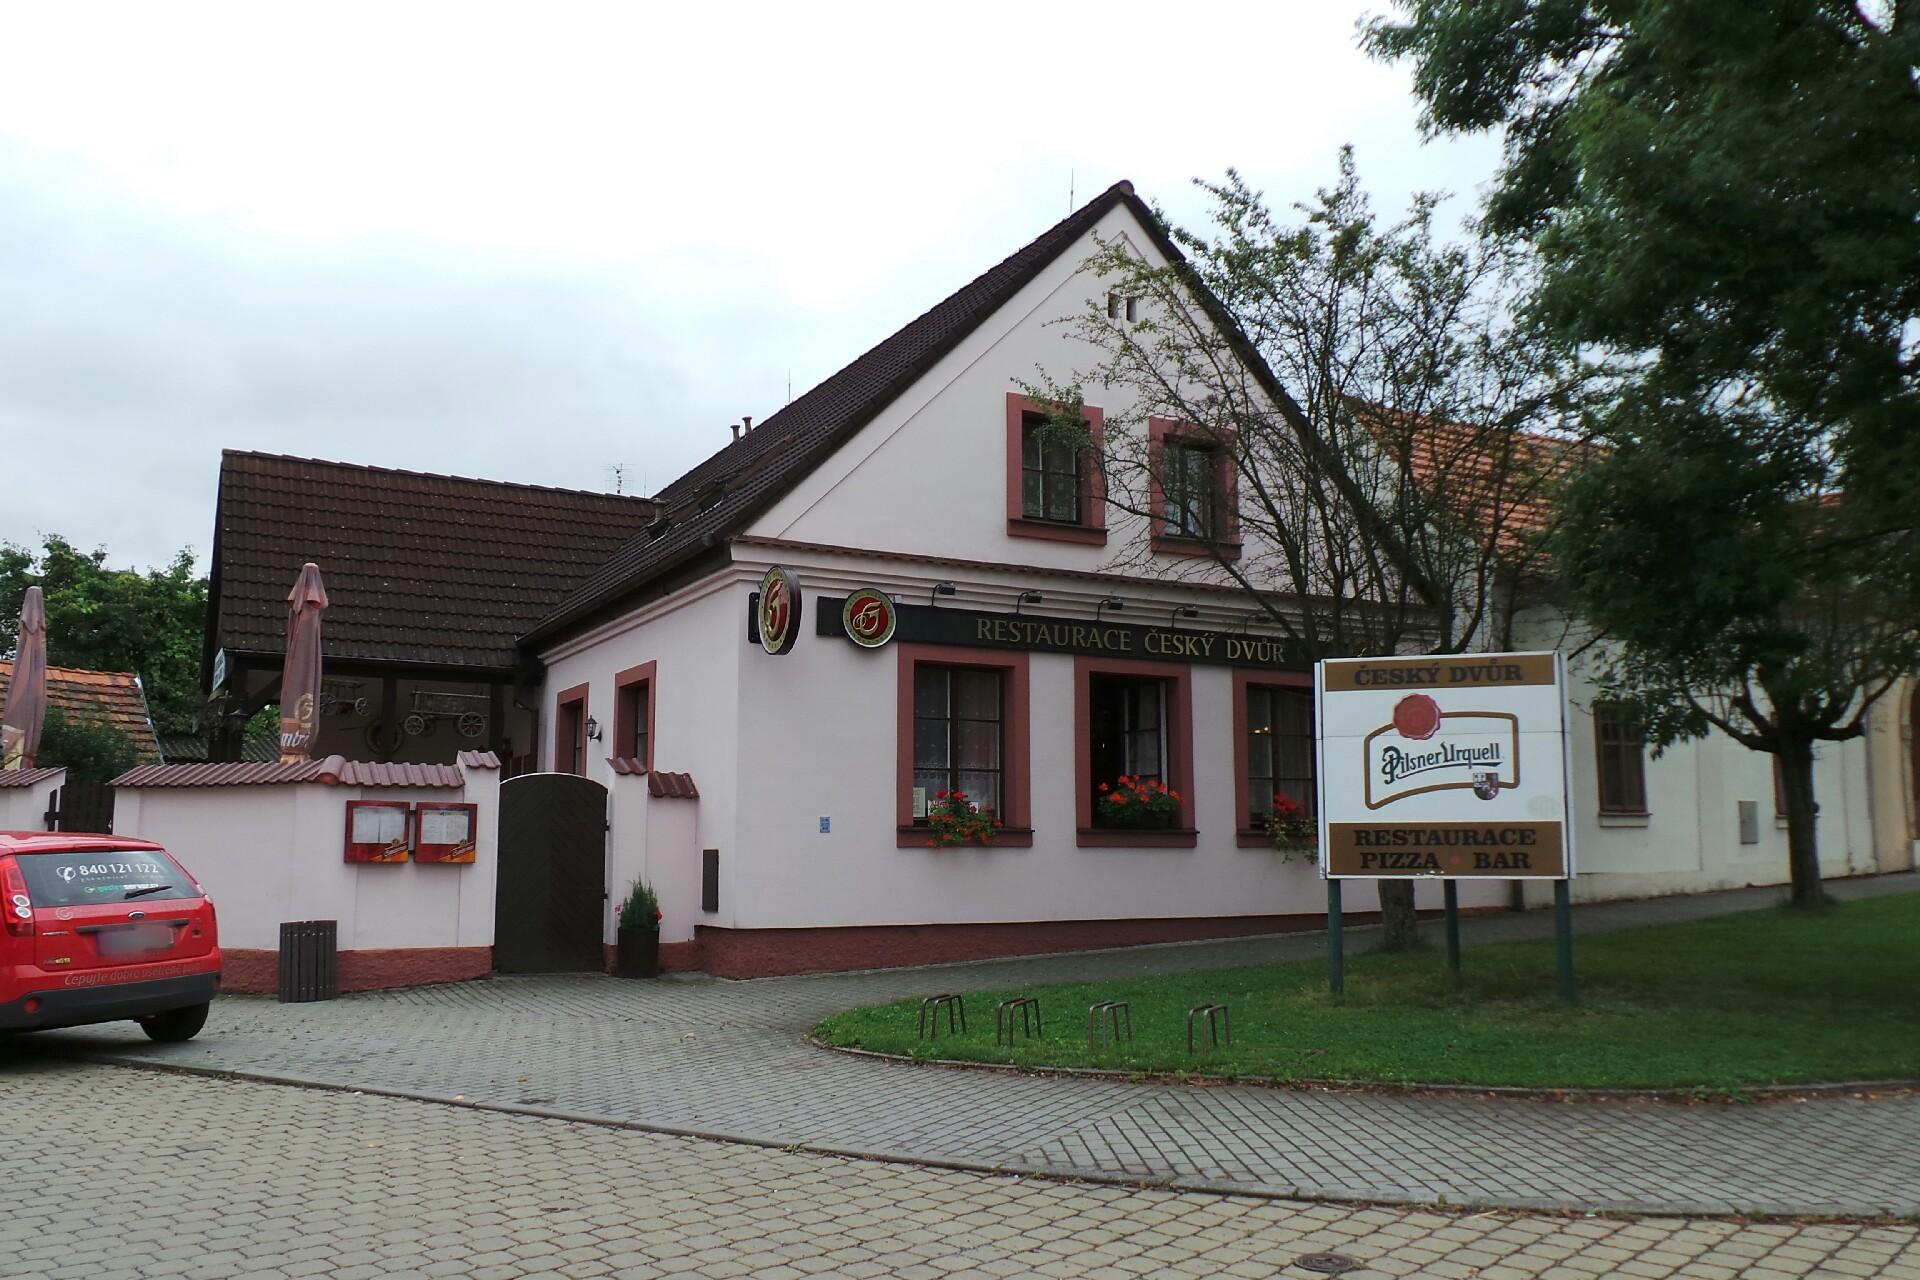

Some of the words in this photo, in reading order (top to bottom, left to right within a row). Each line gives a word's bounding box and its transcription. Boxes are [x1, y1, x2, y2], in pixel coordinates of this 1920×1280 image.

[975, 618, 1132, 651] RESTAURACE
[1144, 628, 1216, 657] ČESKÝ
[1225, 637, 1285, 663] DVŮR
[1354, 662, 1440, 686] ČESKÝ
[1448, 658, 1523, 683] DVŮR
[1381, 745, 1442, 785] Pilsner
[1440, 741, 1501, 769] Urquell
[1354, 828, 1537, 847] RESTAURACE
[79, 864, 107, 876] 840
[110, 863, 132, 874] 121
[135, 862, 159, 873] 122
[1360, 852, 1442, 869] PIZZA
[1473, 852, 1532, 869] BAR
